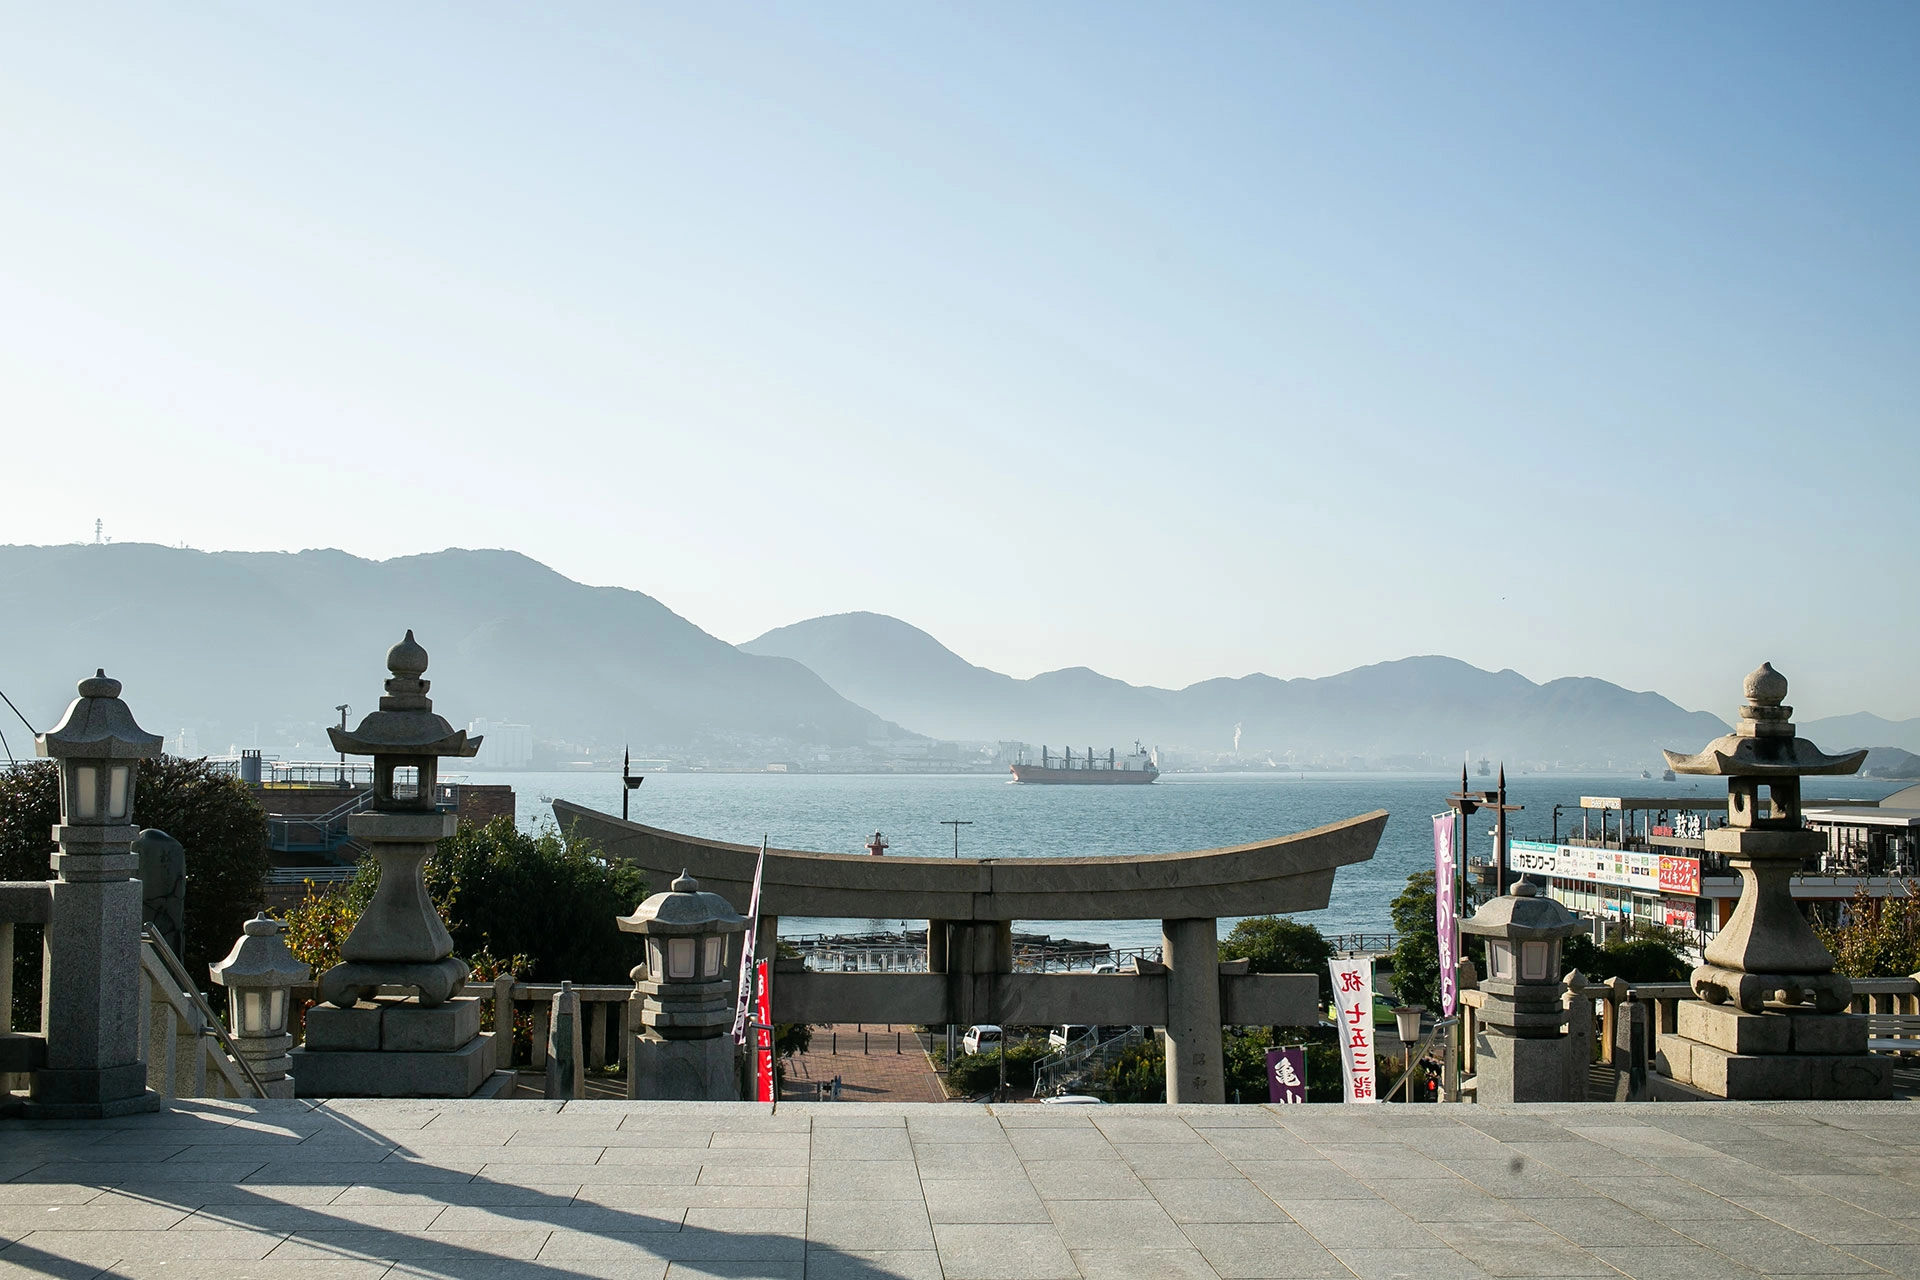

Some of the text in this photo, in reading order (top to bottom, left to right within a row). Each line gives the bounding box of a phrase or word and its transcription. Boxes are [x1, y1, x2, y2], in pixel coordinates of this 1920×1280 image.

[1673, 813, 1702, 839] 敦煌
[1519, 853, 1556, 871] カモンワーフ
[1672, 860, 1691, 872] ランチ
[1660, 871, 1691, 885] バイキング
